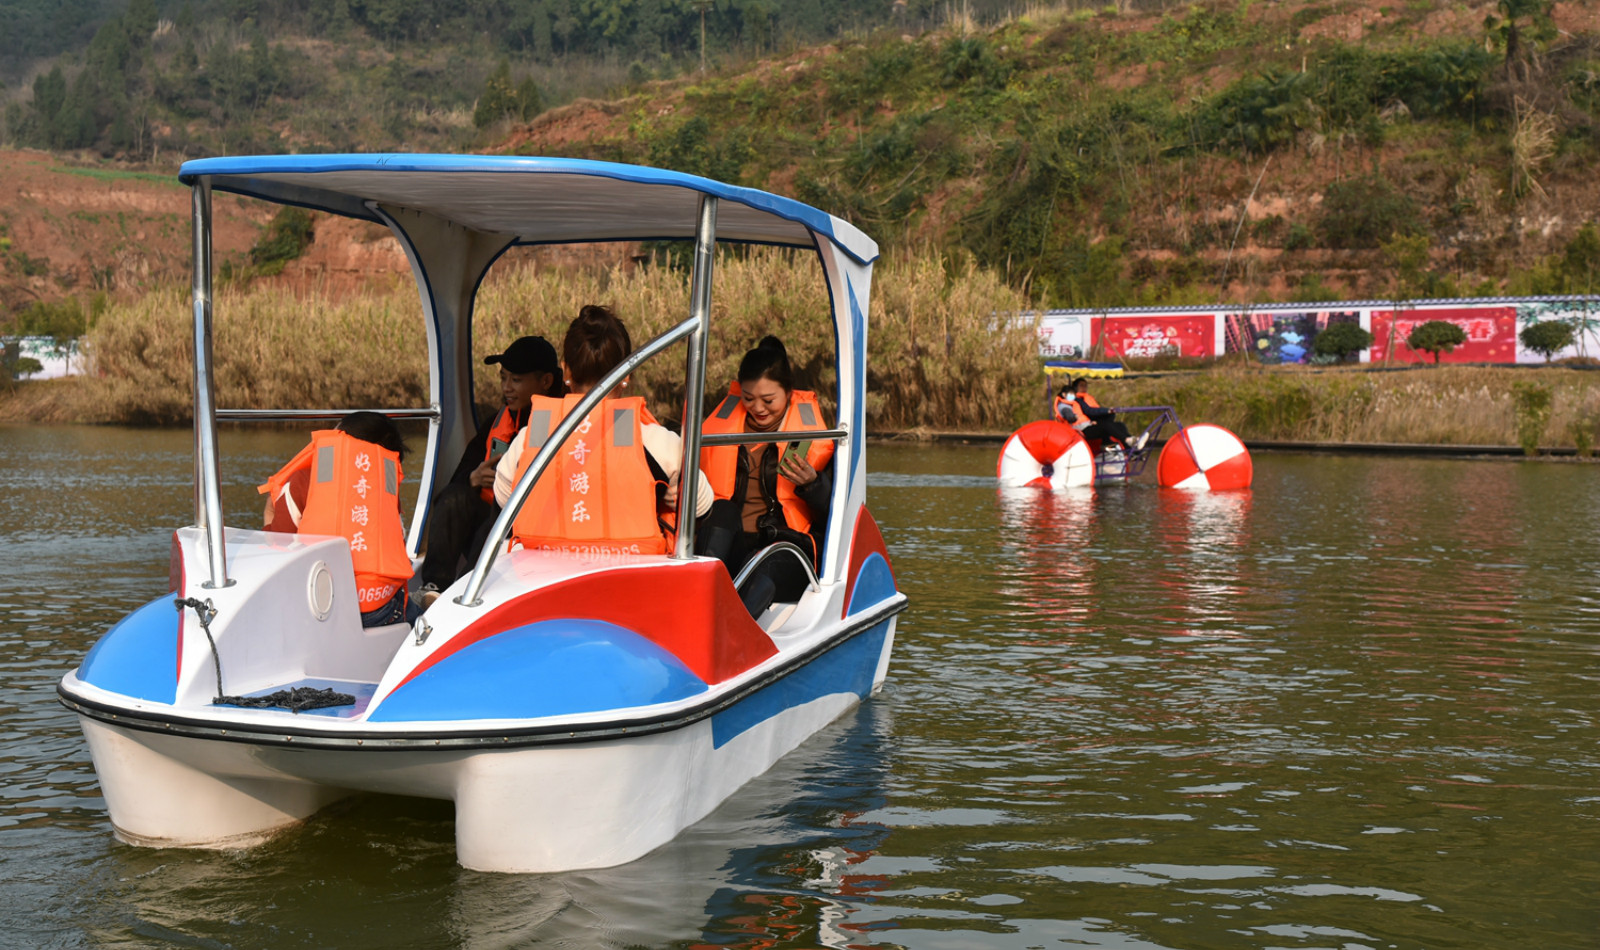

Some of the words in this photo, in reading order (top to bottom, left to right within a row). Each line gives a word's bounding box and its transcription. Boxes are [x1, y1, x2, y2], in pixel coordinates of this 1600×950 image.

[1132, 337, 1170, 348] 2021
[350, 452, 372, 552] 好奇游乐
